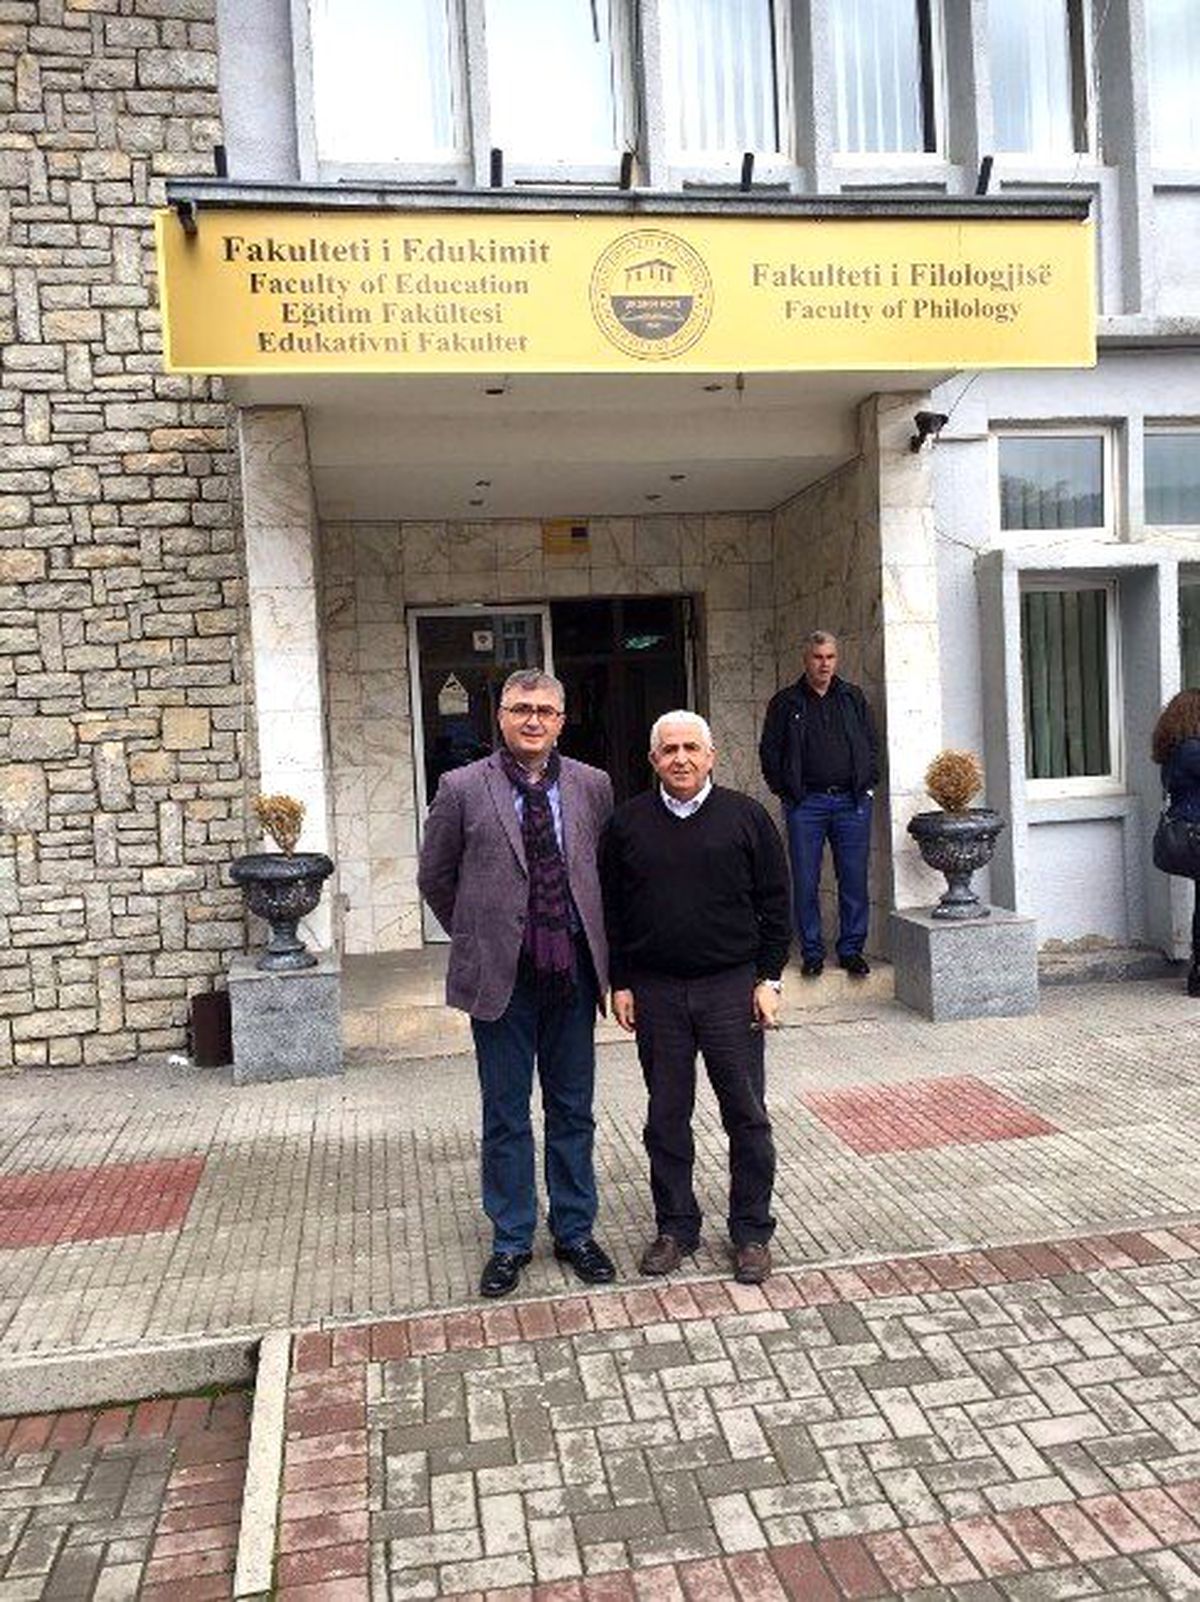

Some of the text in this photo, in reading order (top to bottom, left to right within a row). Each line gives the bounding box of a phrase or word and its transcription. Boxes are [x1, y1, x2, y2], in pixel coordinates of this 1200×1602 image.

[222, 235, 551, 264] Fakulteti i Edukimit
[249, 272, 530, 300] Faculty of Education
[752, 263, 1053, 292] Fakulteti i Filologjisë
[281, 302, 503, 327] Eğitim Fakültesi
[785, 299, 1022, 322] Faculty of Philology
[257, 331, 528, 354] Edukativni Fakultet
